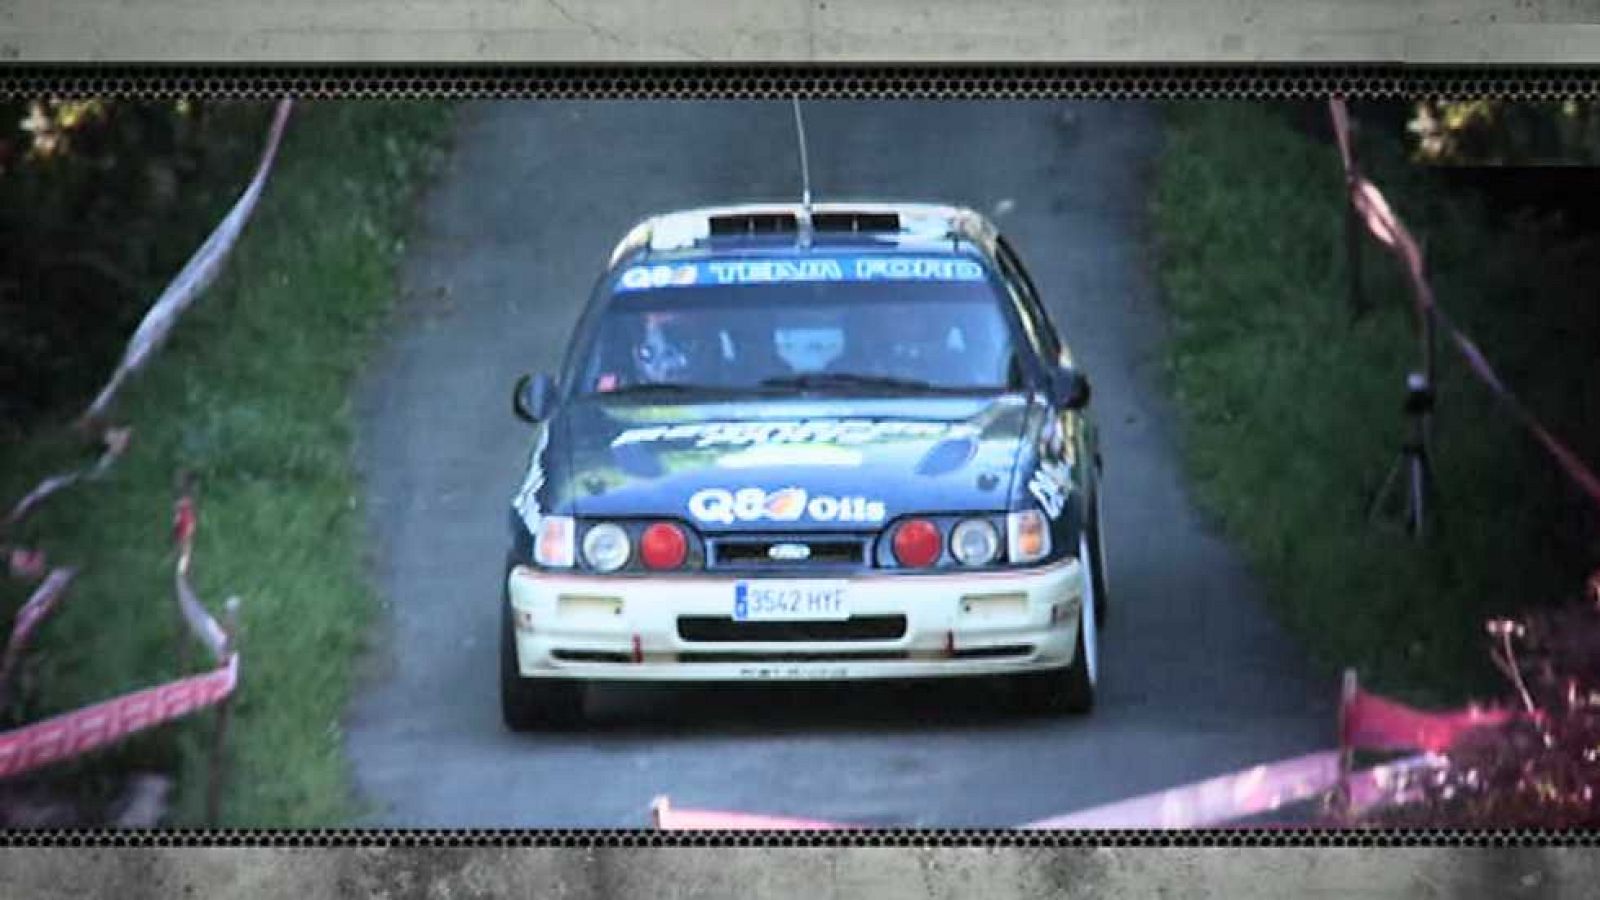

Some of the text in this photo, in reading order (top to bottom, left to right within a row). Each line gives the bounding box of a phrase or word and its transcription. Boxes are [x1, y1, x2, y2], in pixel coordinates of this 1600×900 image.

[856, 258, 983, 281] FORD
[688, 487, 886, 524] Q8 Oils
[750, 588, 801, 612] 3542
[807, 588, 847, 611] HYF
